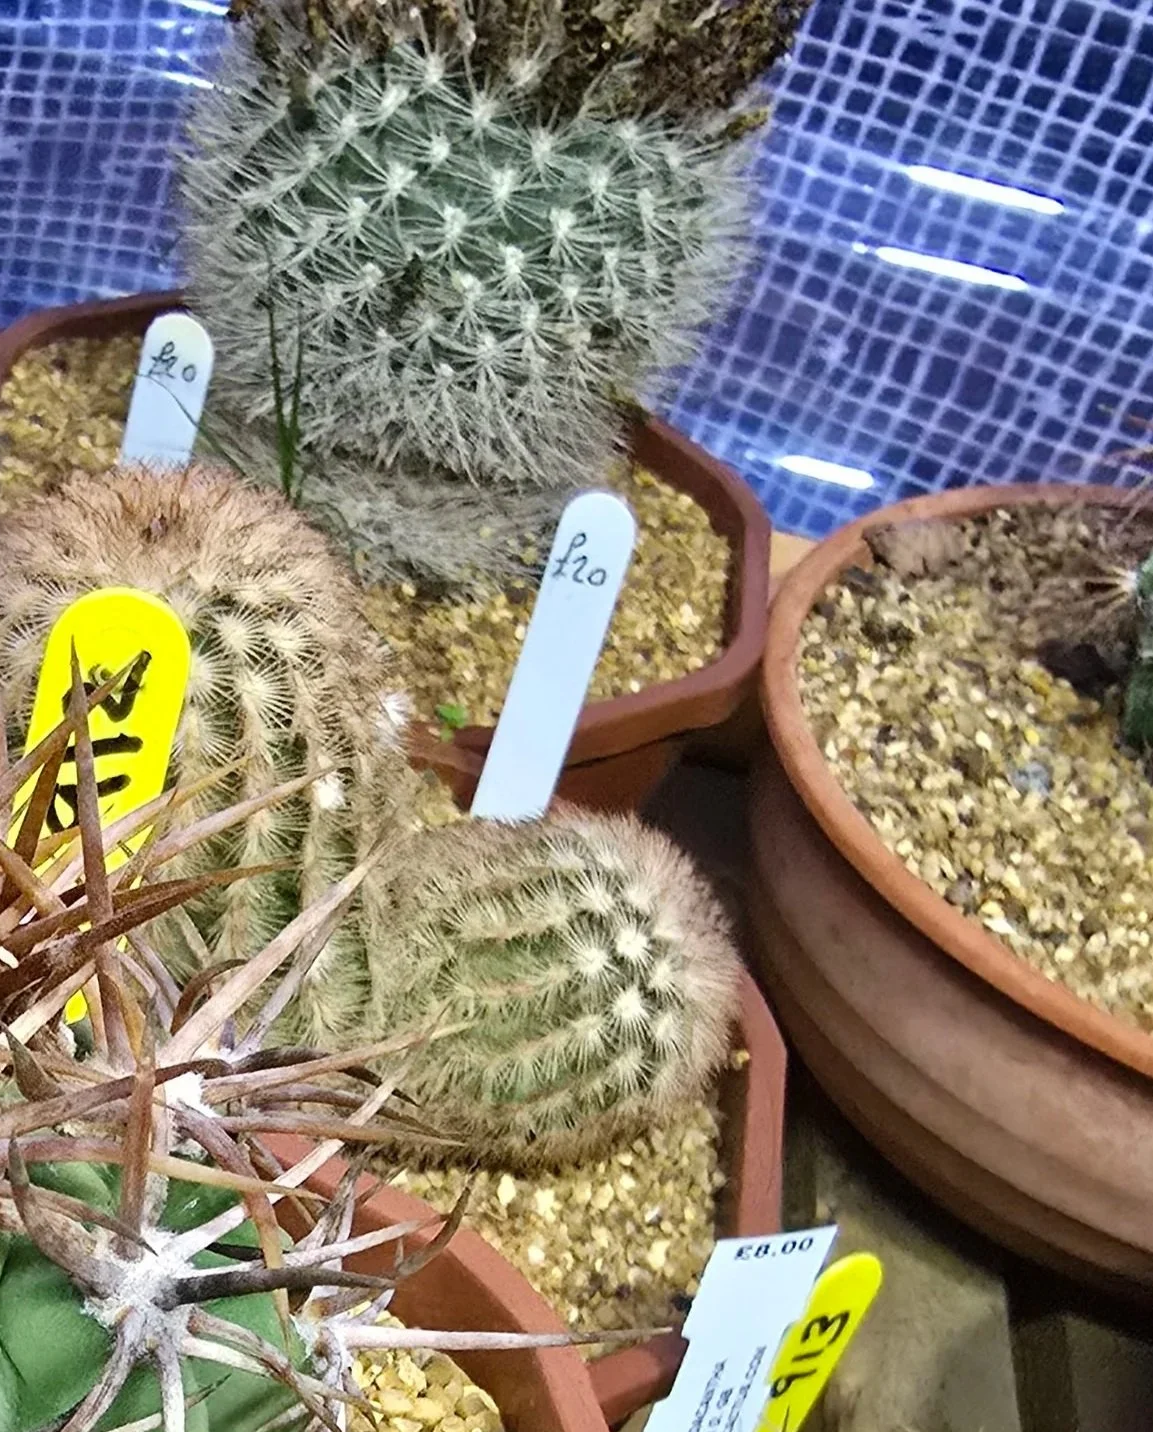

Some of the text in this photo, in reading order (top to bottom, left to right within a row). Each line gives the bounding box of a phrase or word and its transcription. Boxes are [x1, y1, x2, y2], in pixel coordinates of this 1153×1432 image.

[149, 341, 197, 383] £20
[551, 532, 607, 586] £20
[734, 1236, 815, 1260] £8.00
[769, 1310, 851, 1398] 913
